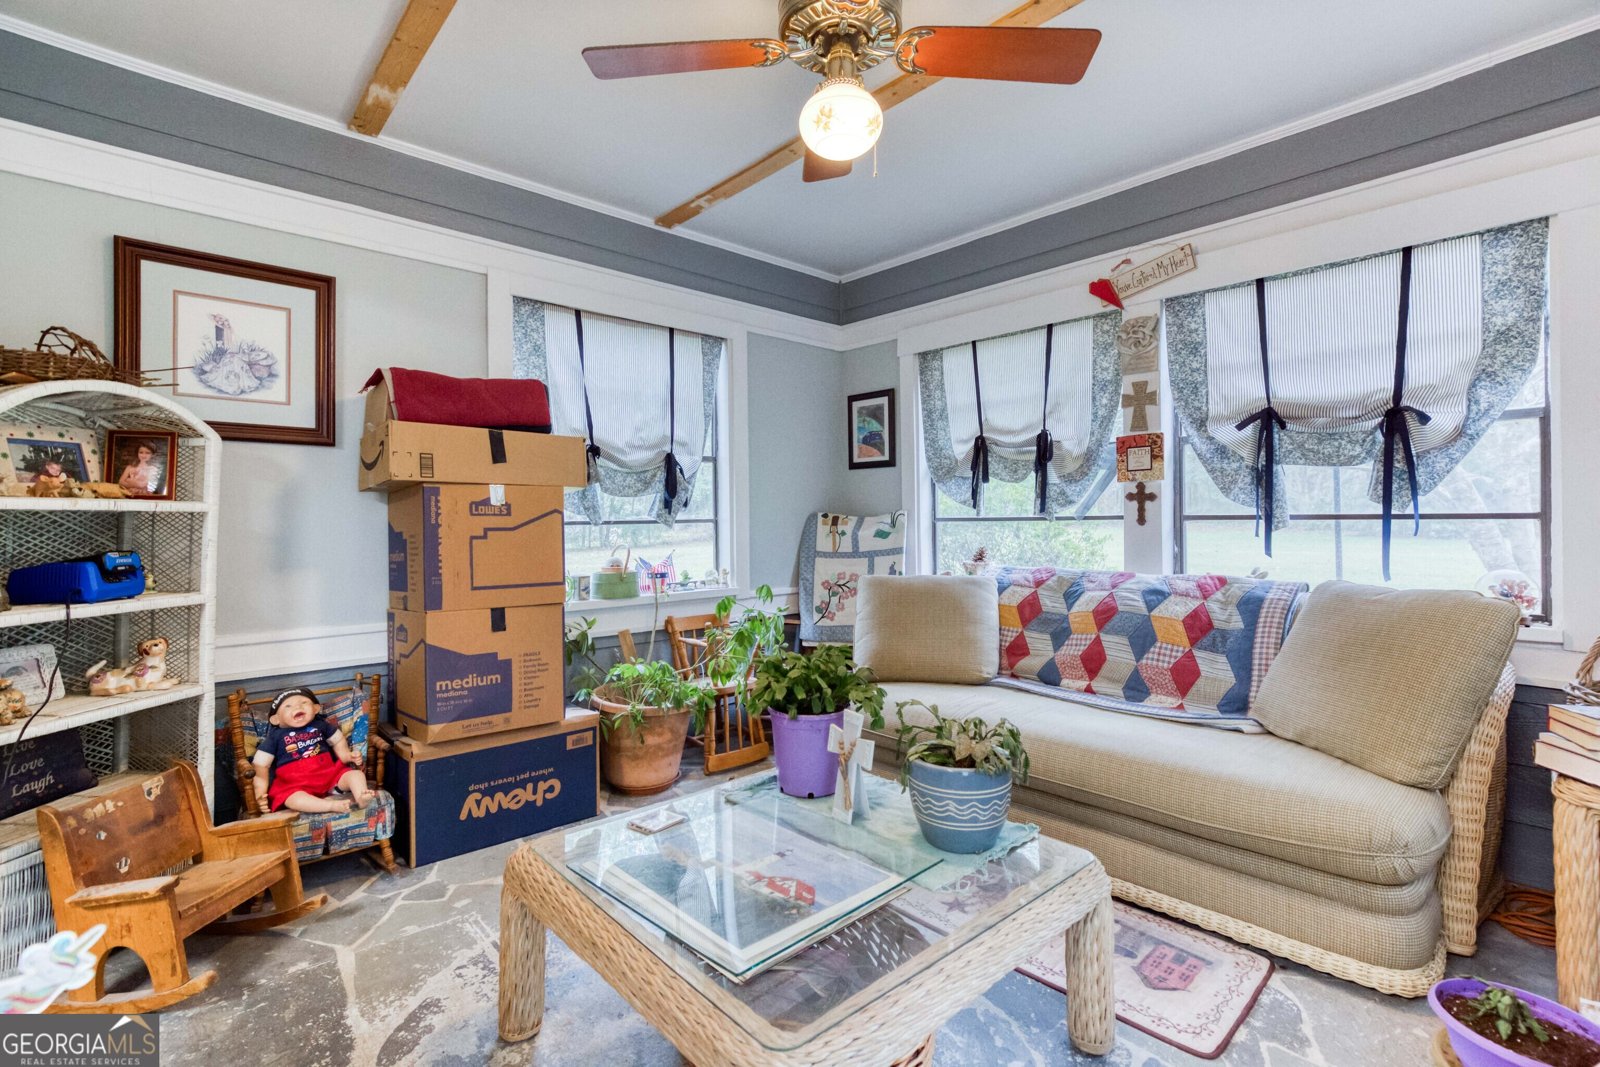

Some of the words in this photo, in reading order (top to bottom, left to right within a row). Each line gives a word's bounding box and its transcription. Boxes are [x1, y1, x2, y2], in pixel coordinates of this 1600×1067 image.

[1156, 260, 1170, 278] My
[436, 673, 501, 691] medium
[436, 690, 468, 699] mediana
[8, 757, 45, 777] Love
[531, 767, 554, 775] where
[490, 776, 515, 787] lovers
[516, 771, 530, 781] pet
[11, 770, 55, 798] Laugh
[468, 782, 489, 791] shop
[459, 778, 561, 821] chewy
